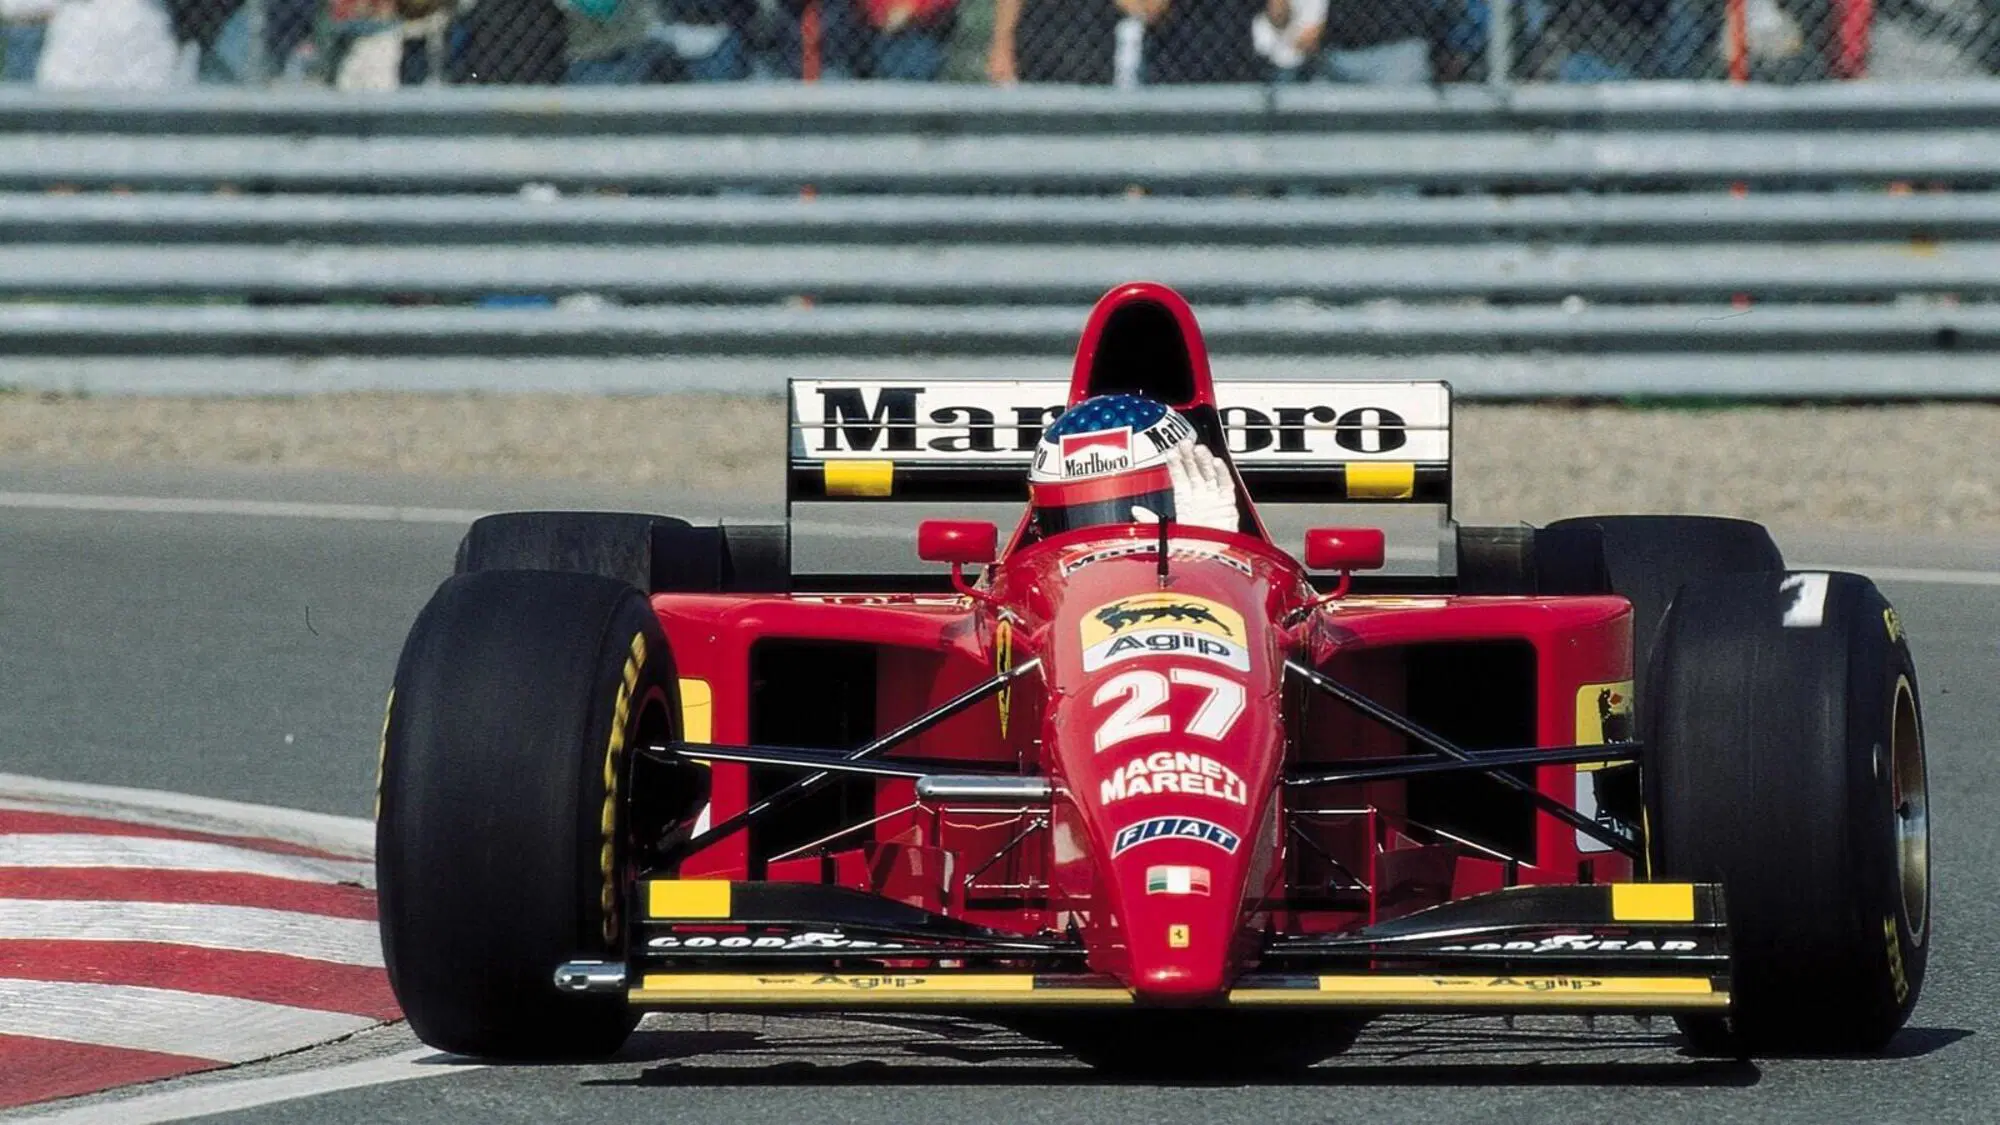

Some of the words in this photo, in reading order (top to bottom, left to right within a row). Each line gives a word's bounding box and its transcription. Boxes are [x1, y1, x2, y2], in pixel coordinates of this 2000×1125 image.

[815, 387, 1406, 455] Maroro
[1063, 452, 1130, 477] Marlboro
[1104, 632, 1231, 659] Agip
[1092, 667, 1247, 753] 27
[1101, 769, 1247, 805] MARELLI
[1121, 820, 1232, 847] FIAT
[811, 974, 927, 990] Agip
[1486, 976, 1603, 991] Agip
